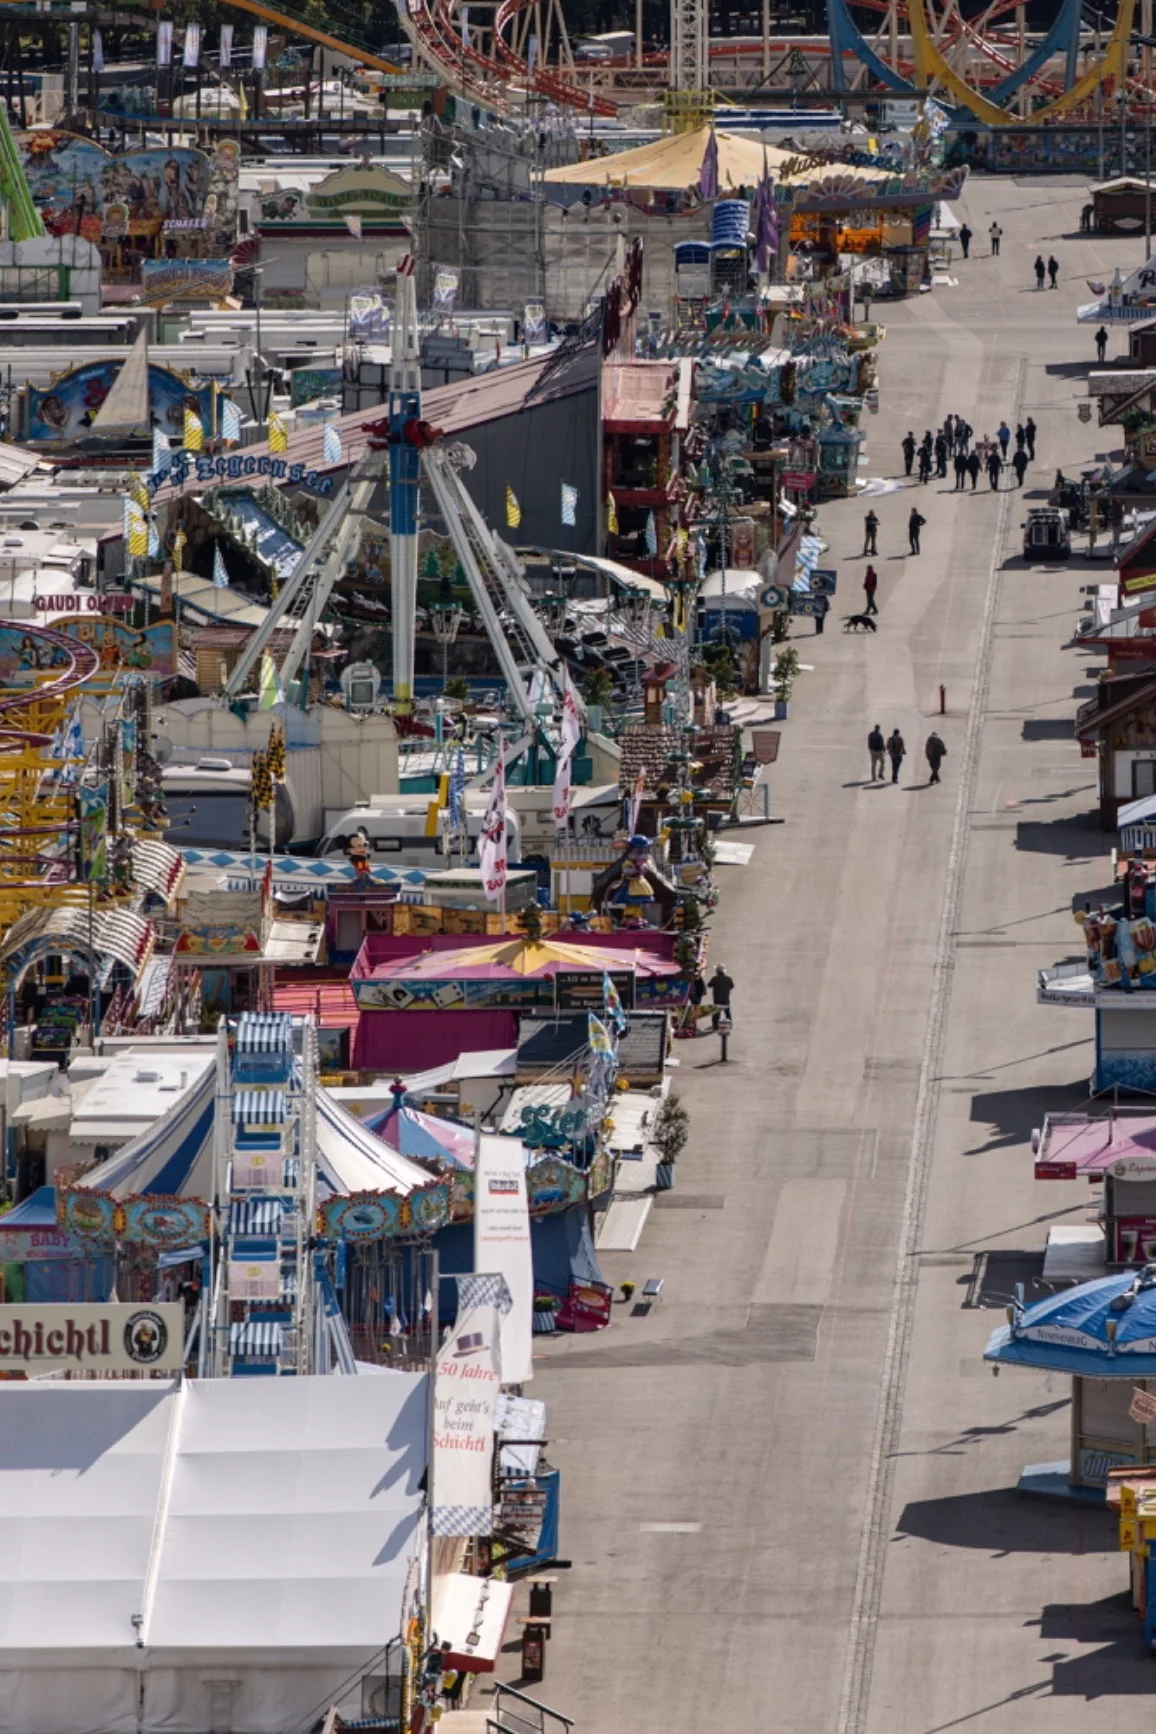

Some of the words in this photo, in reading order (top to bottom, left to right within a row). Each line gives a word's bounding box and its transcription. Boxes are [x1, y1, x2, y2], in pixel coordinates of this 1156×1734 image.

[36, 595, 80, 611] GAUDI
[459, 1363, 499, 1381] Jahre
[443, 1416, 475, 1432] beim
